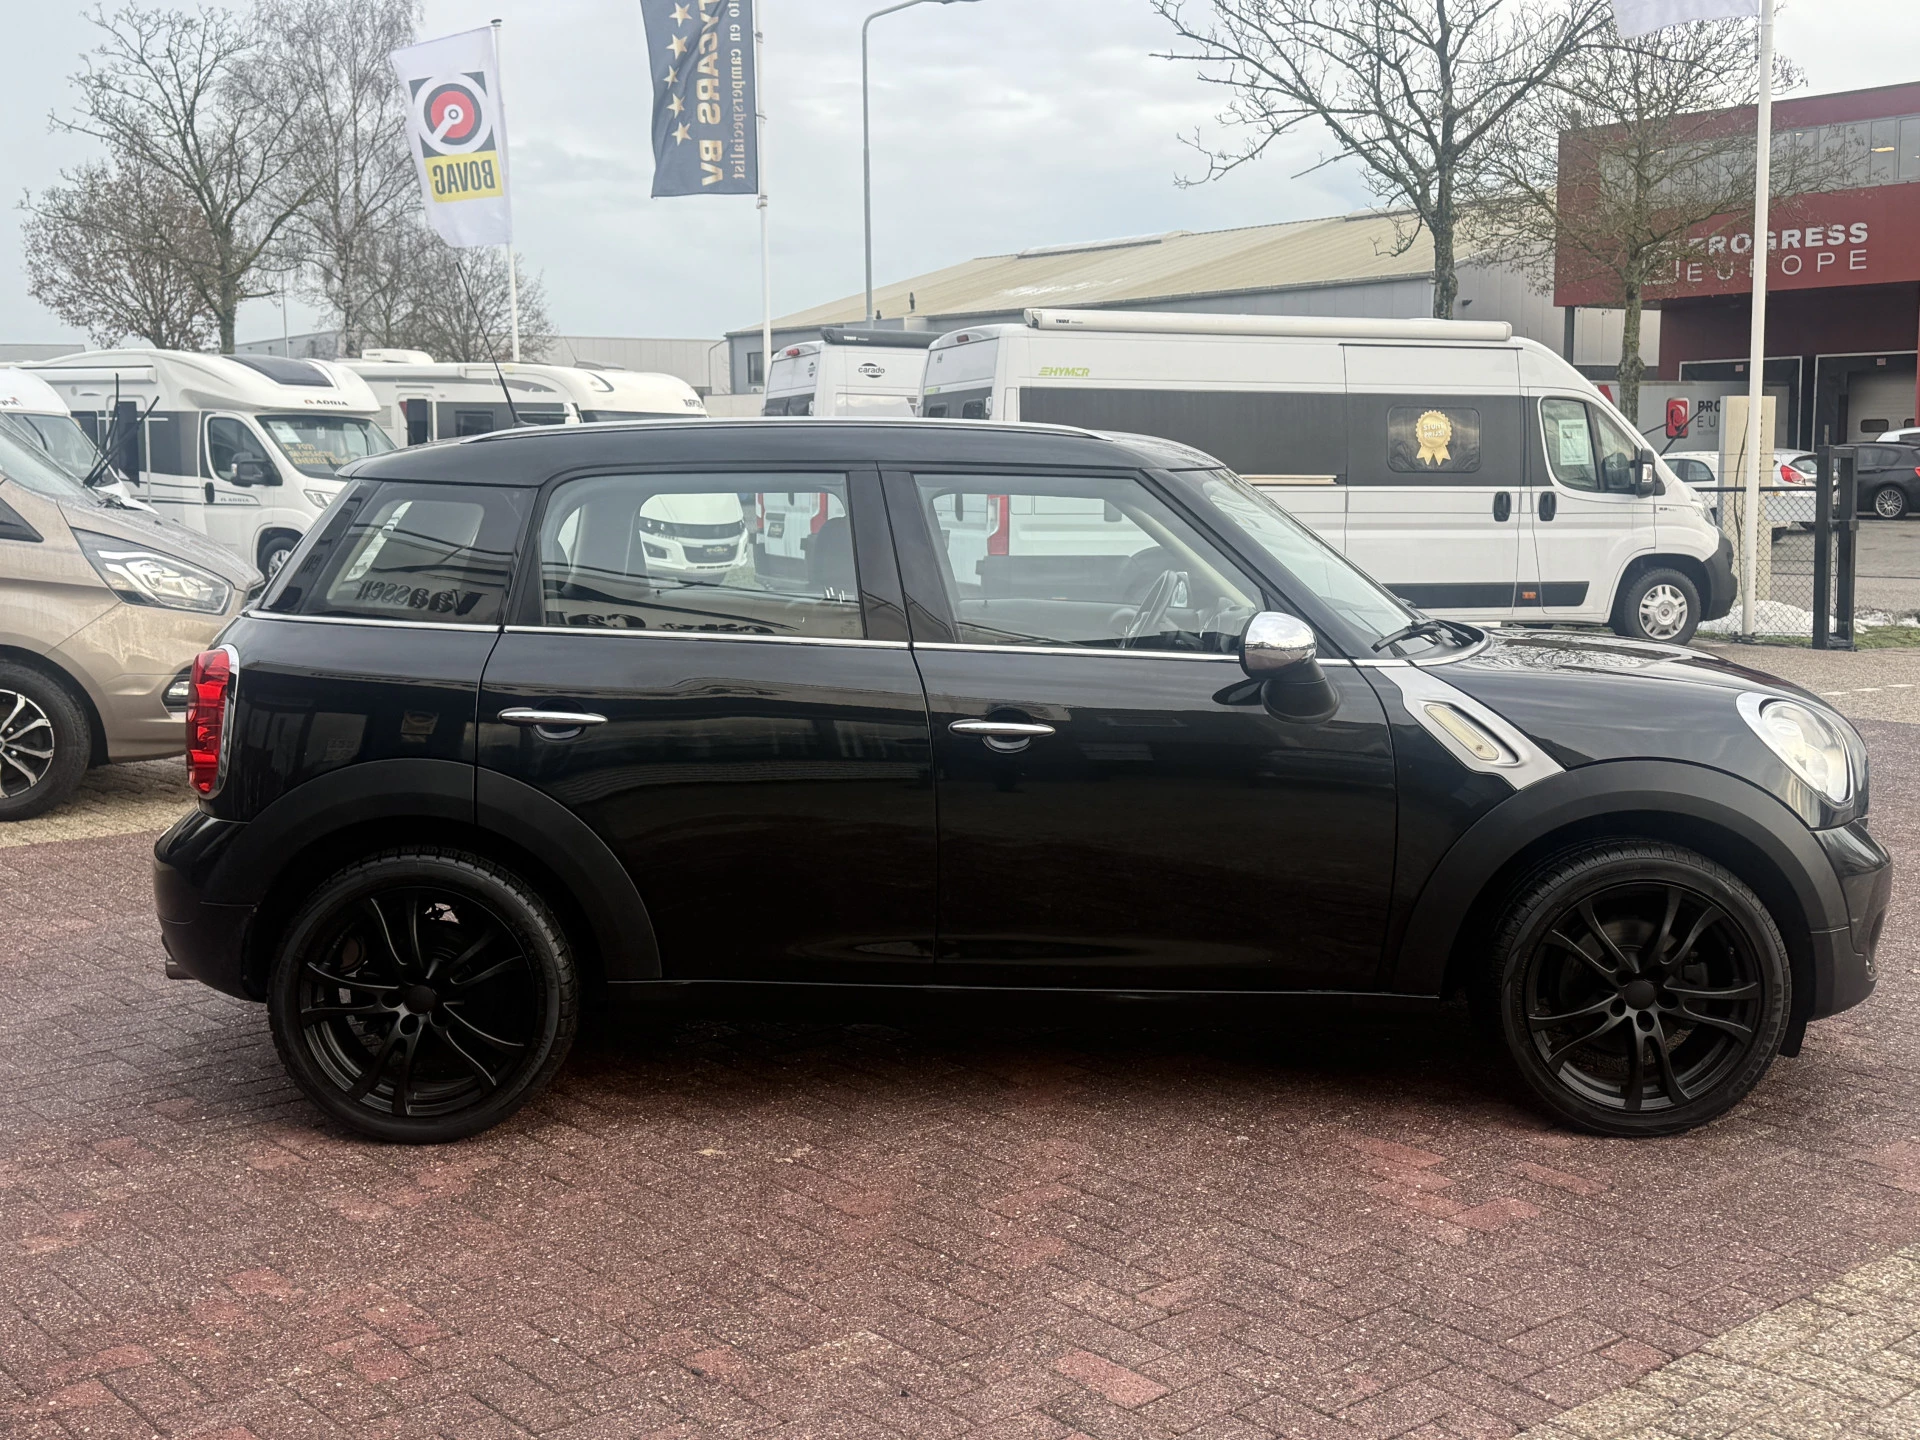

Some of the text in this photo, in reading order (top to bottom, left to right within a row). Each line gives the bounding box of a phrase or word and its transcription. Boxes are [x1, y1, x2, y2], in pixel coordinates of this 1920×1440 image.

[1686, 249, 1868, 283] EUOPE
[858, 365, 885, 374] carado
[1423, 422, 1445, 431] STUNT
[1771, 983, 1782, 1013] ALL
